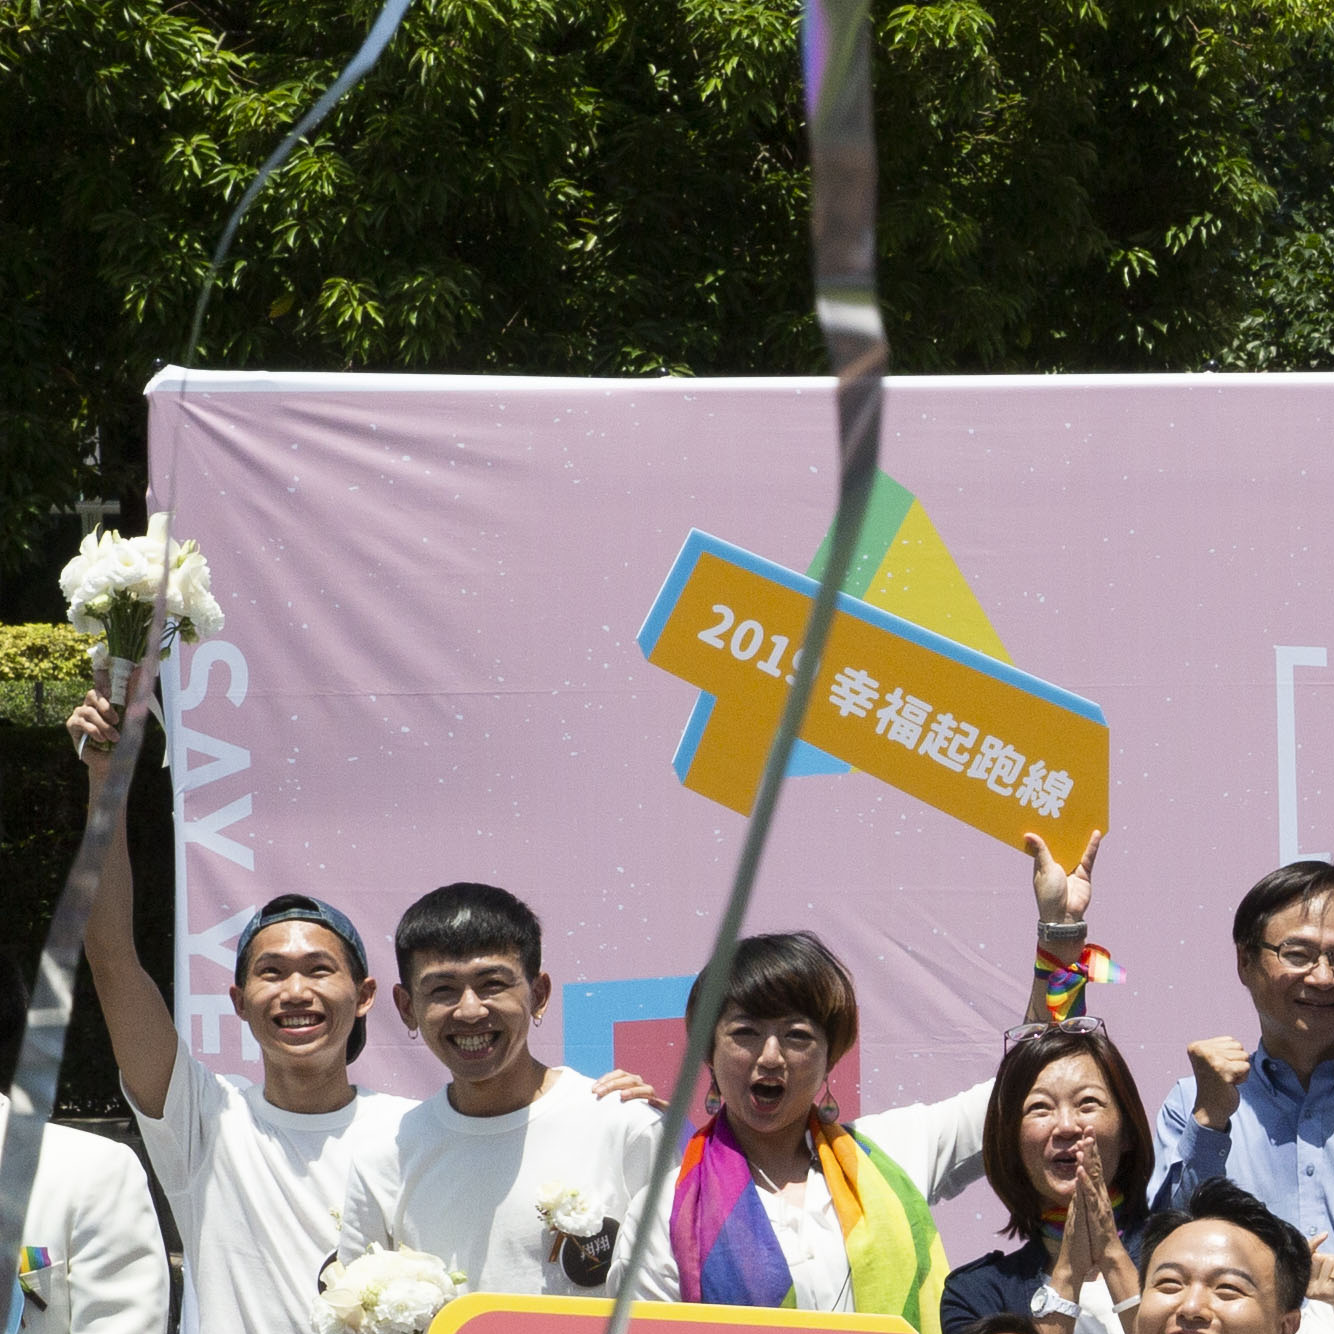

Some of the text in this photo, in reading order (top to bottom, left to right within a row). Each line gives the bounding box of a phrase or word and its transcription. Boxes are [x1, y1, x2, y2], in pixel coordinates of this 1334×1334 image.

[177, 640, 263, 1092] SAY YE
[828, 665, 1075, 820] 幸福起跑線
